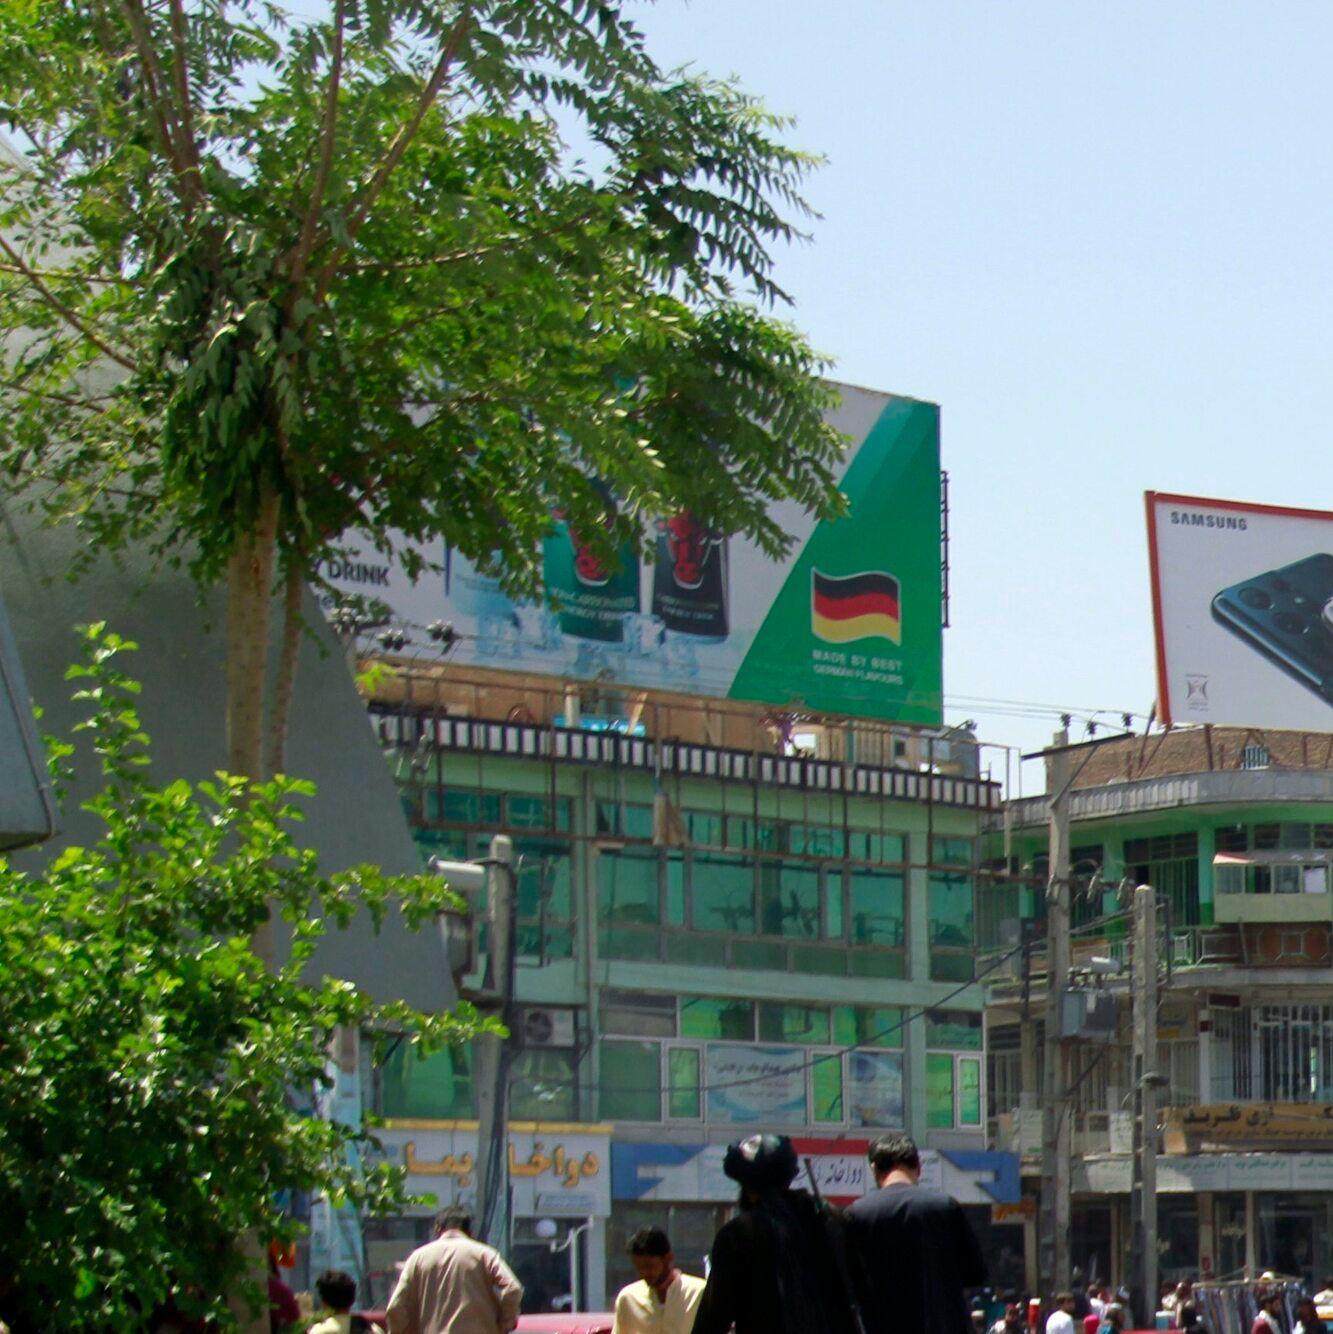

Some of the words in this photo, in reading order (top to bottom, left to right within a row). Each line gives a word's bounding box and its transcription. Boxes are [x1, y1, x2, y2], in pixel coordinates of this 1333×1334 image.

[1170, 511, 1248, 531] SAMSUNG
[328, 558, 390, 586] DRINK
[812, 649, 846, 664] MADE
[850, 655, 866, 667] BY
